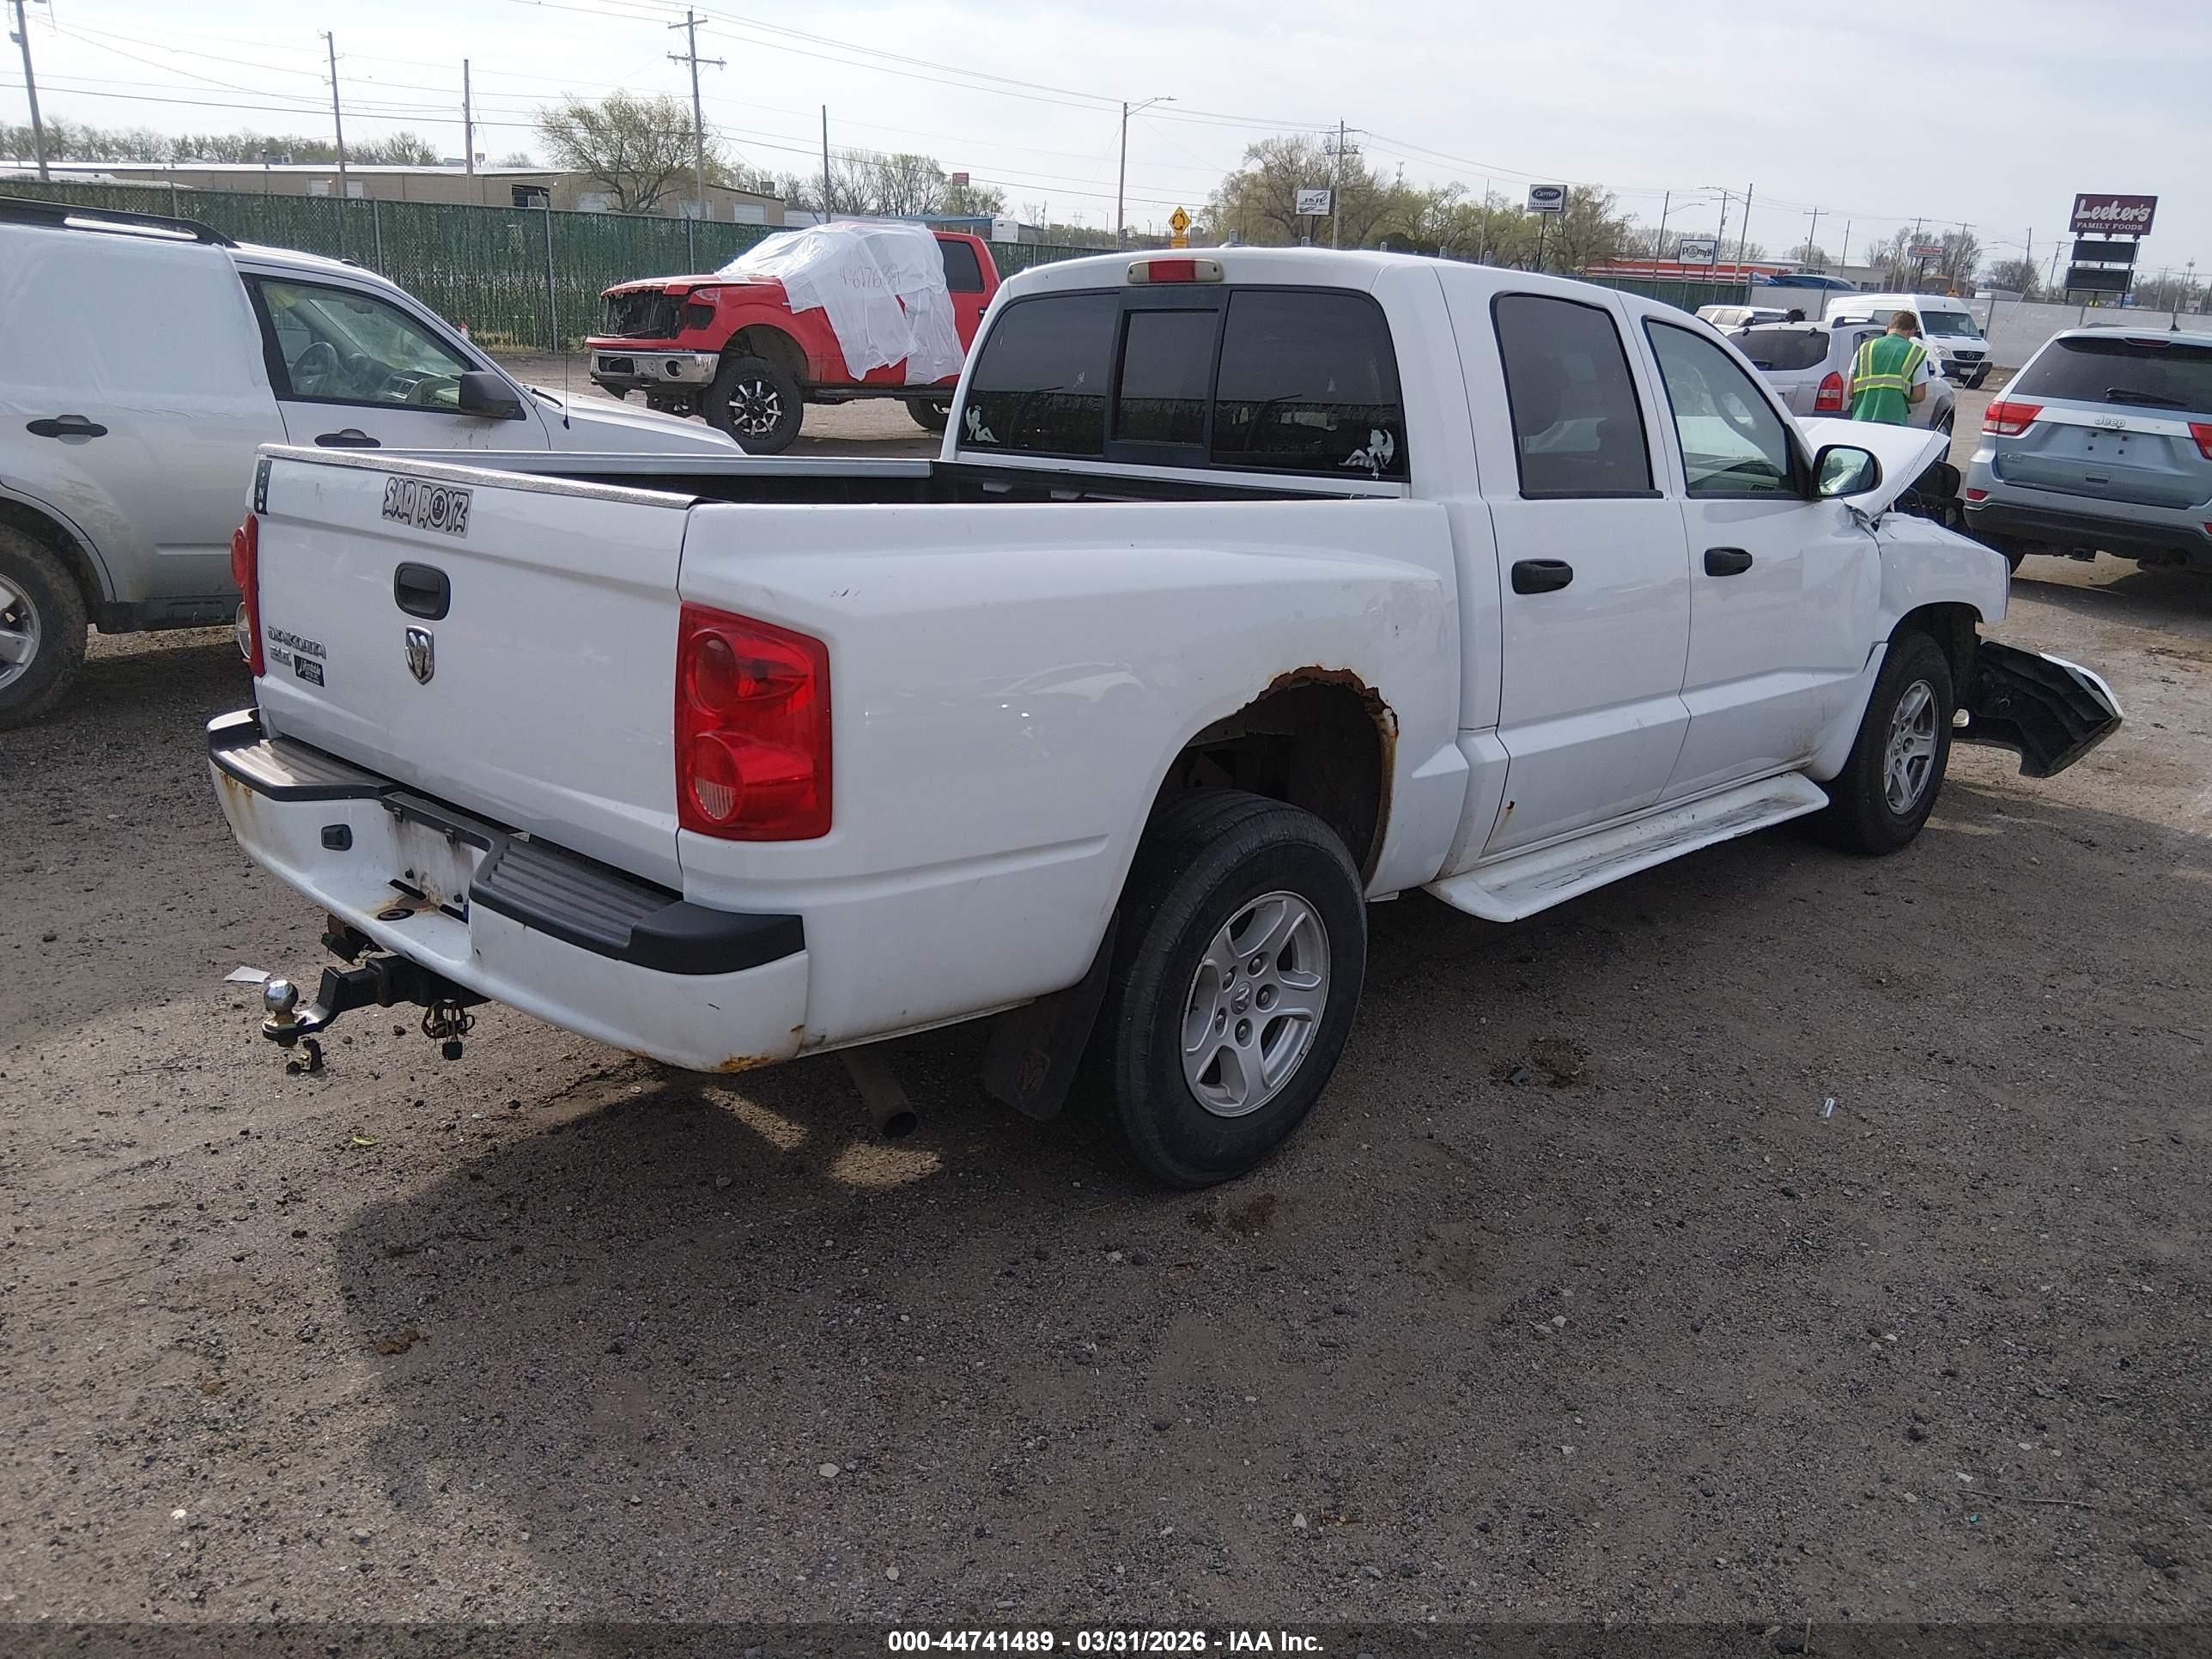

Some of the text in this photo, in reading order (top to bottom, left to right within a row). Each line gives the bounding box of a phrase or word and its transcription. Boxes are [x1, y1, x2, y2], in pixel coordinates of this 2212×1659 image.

[2075, 198, 2151, 222] Leeker's
[2076, 222, 2111, 230] FAMILY
[2094, 416, 2126, 428] Jeep
[383, 477, 470, 533] SAD BOYZ
[268, 625, 327, 660] DAKOTA
